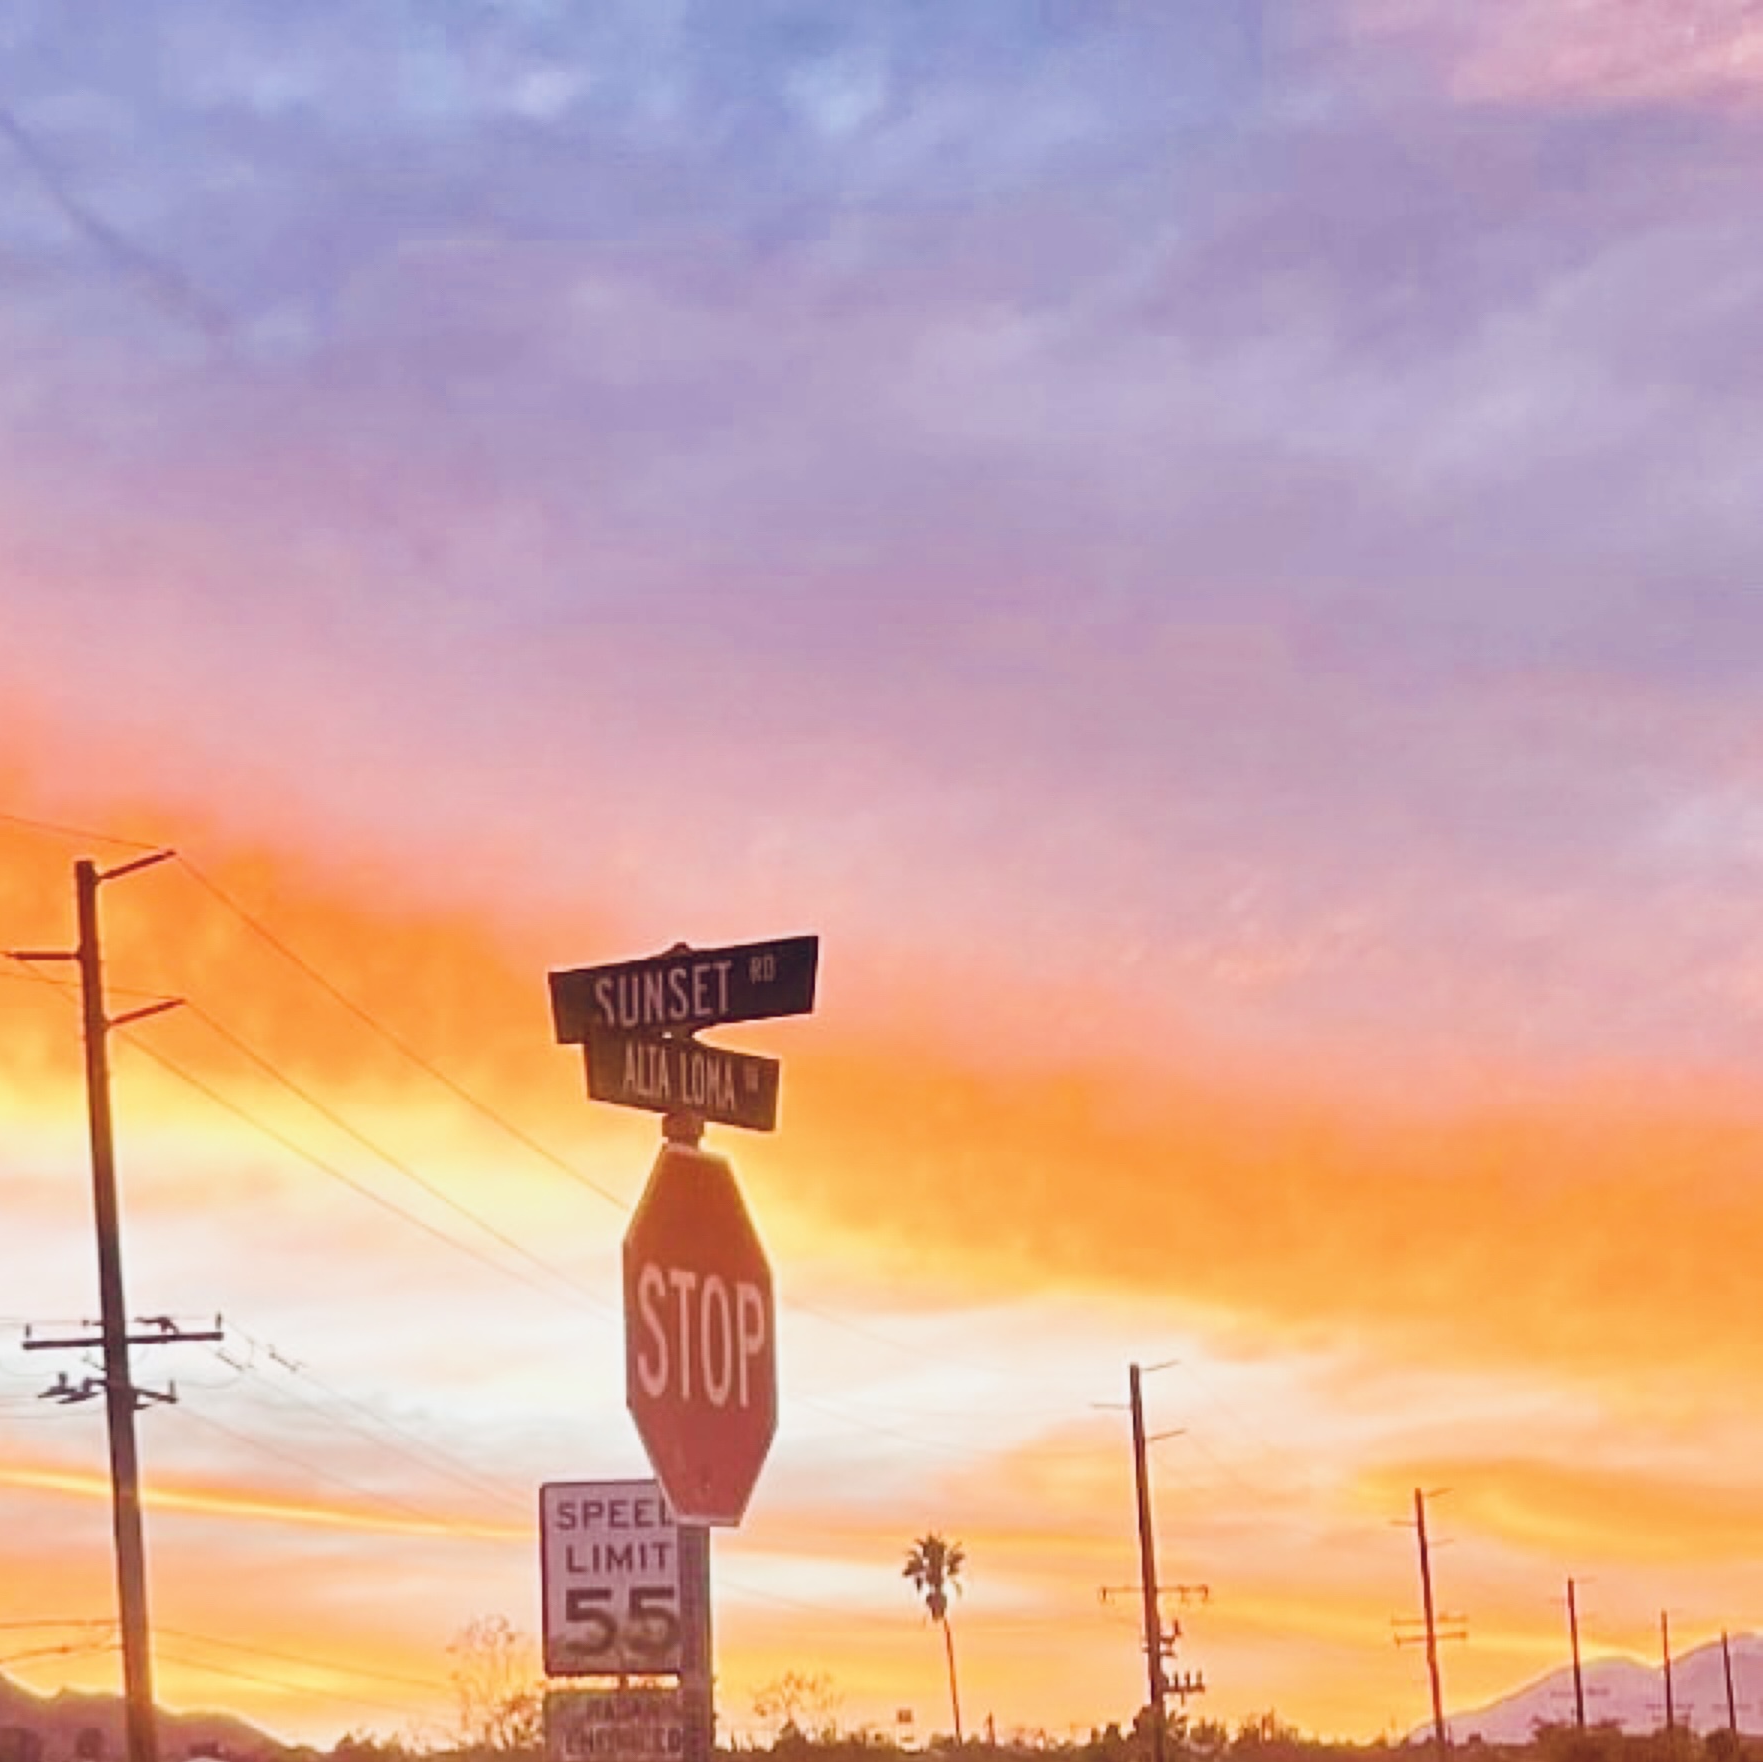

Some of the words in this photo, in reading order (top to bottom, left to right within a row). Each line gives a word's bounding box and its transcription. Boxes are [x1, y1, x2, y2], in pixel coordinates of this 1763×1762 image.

[595, 961, 732, 1028] SUNSET
[749, 954, 776, 984] RD
[623, 1041, 670, 1099] ALTA
[680, 1051, 736, 1111] LOMA
[638, 1262, 764, 1408] STOP
[565, 1541, 672, 1573] LIMIT
[565, 1586, 680, 1656] 55
